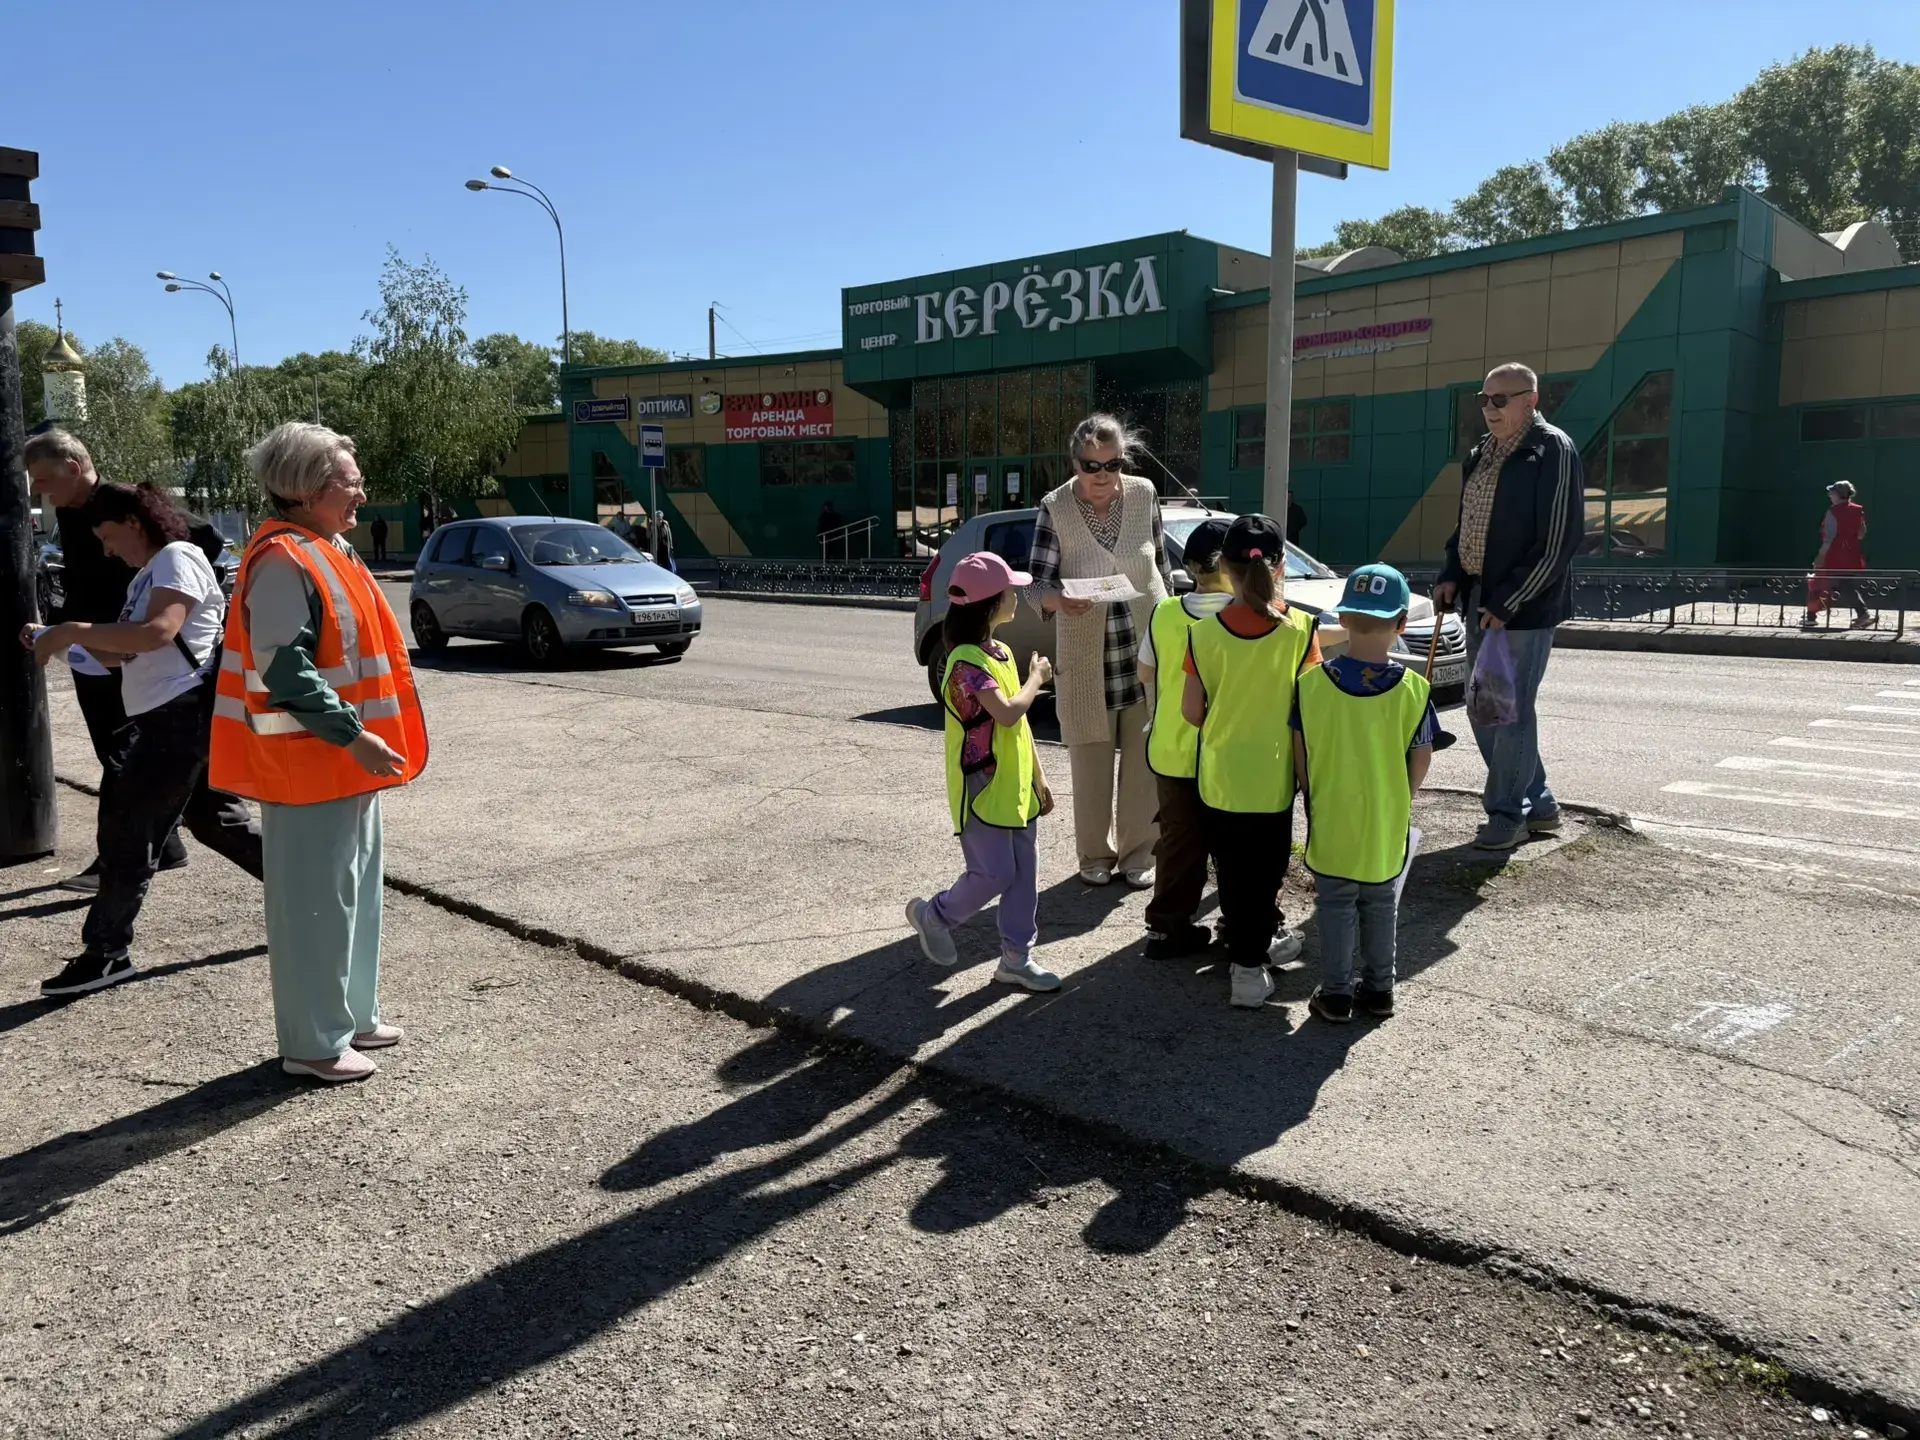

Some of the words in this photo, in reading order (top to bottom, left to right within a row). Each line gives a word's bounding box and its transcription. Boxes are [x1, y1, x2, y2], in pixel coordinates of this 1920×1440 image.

[848, 294, 910, 316] ТОРГОВЫЙ
[913, 255, 1168, 345] БЕРЁЗКА
[860, 333, 898, 351] ЦЕНТР
[637, 399, 686, 414] ОПТИКА
[751, 409, 805, 423] АРЕНДА
[726, 425, 796, 439] ТОРГОВЫХ
[799, 423, 832, 436] МЕСТ
[1353, 574, 1387, 595] GO
